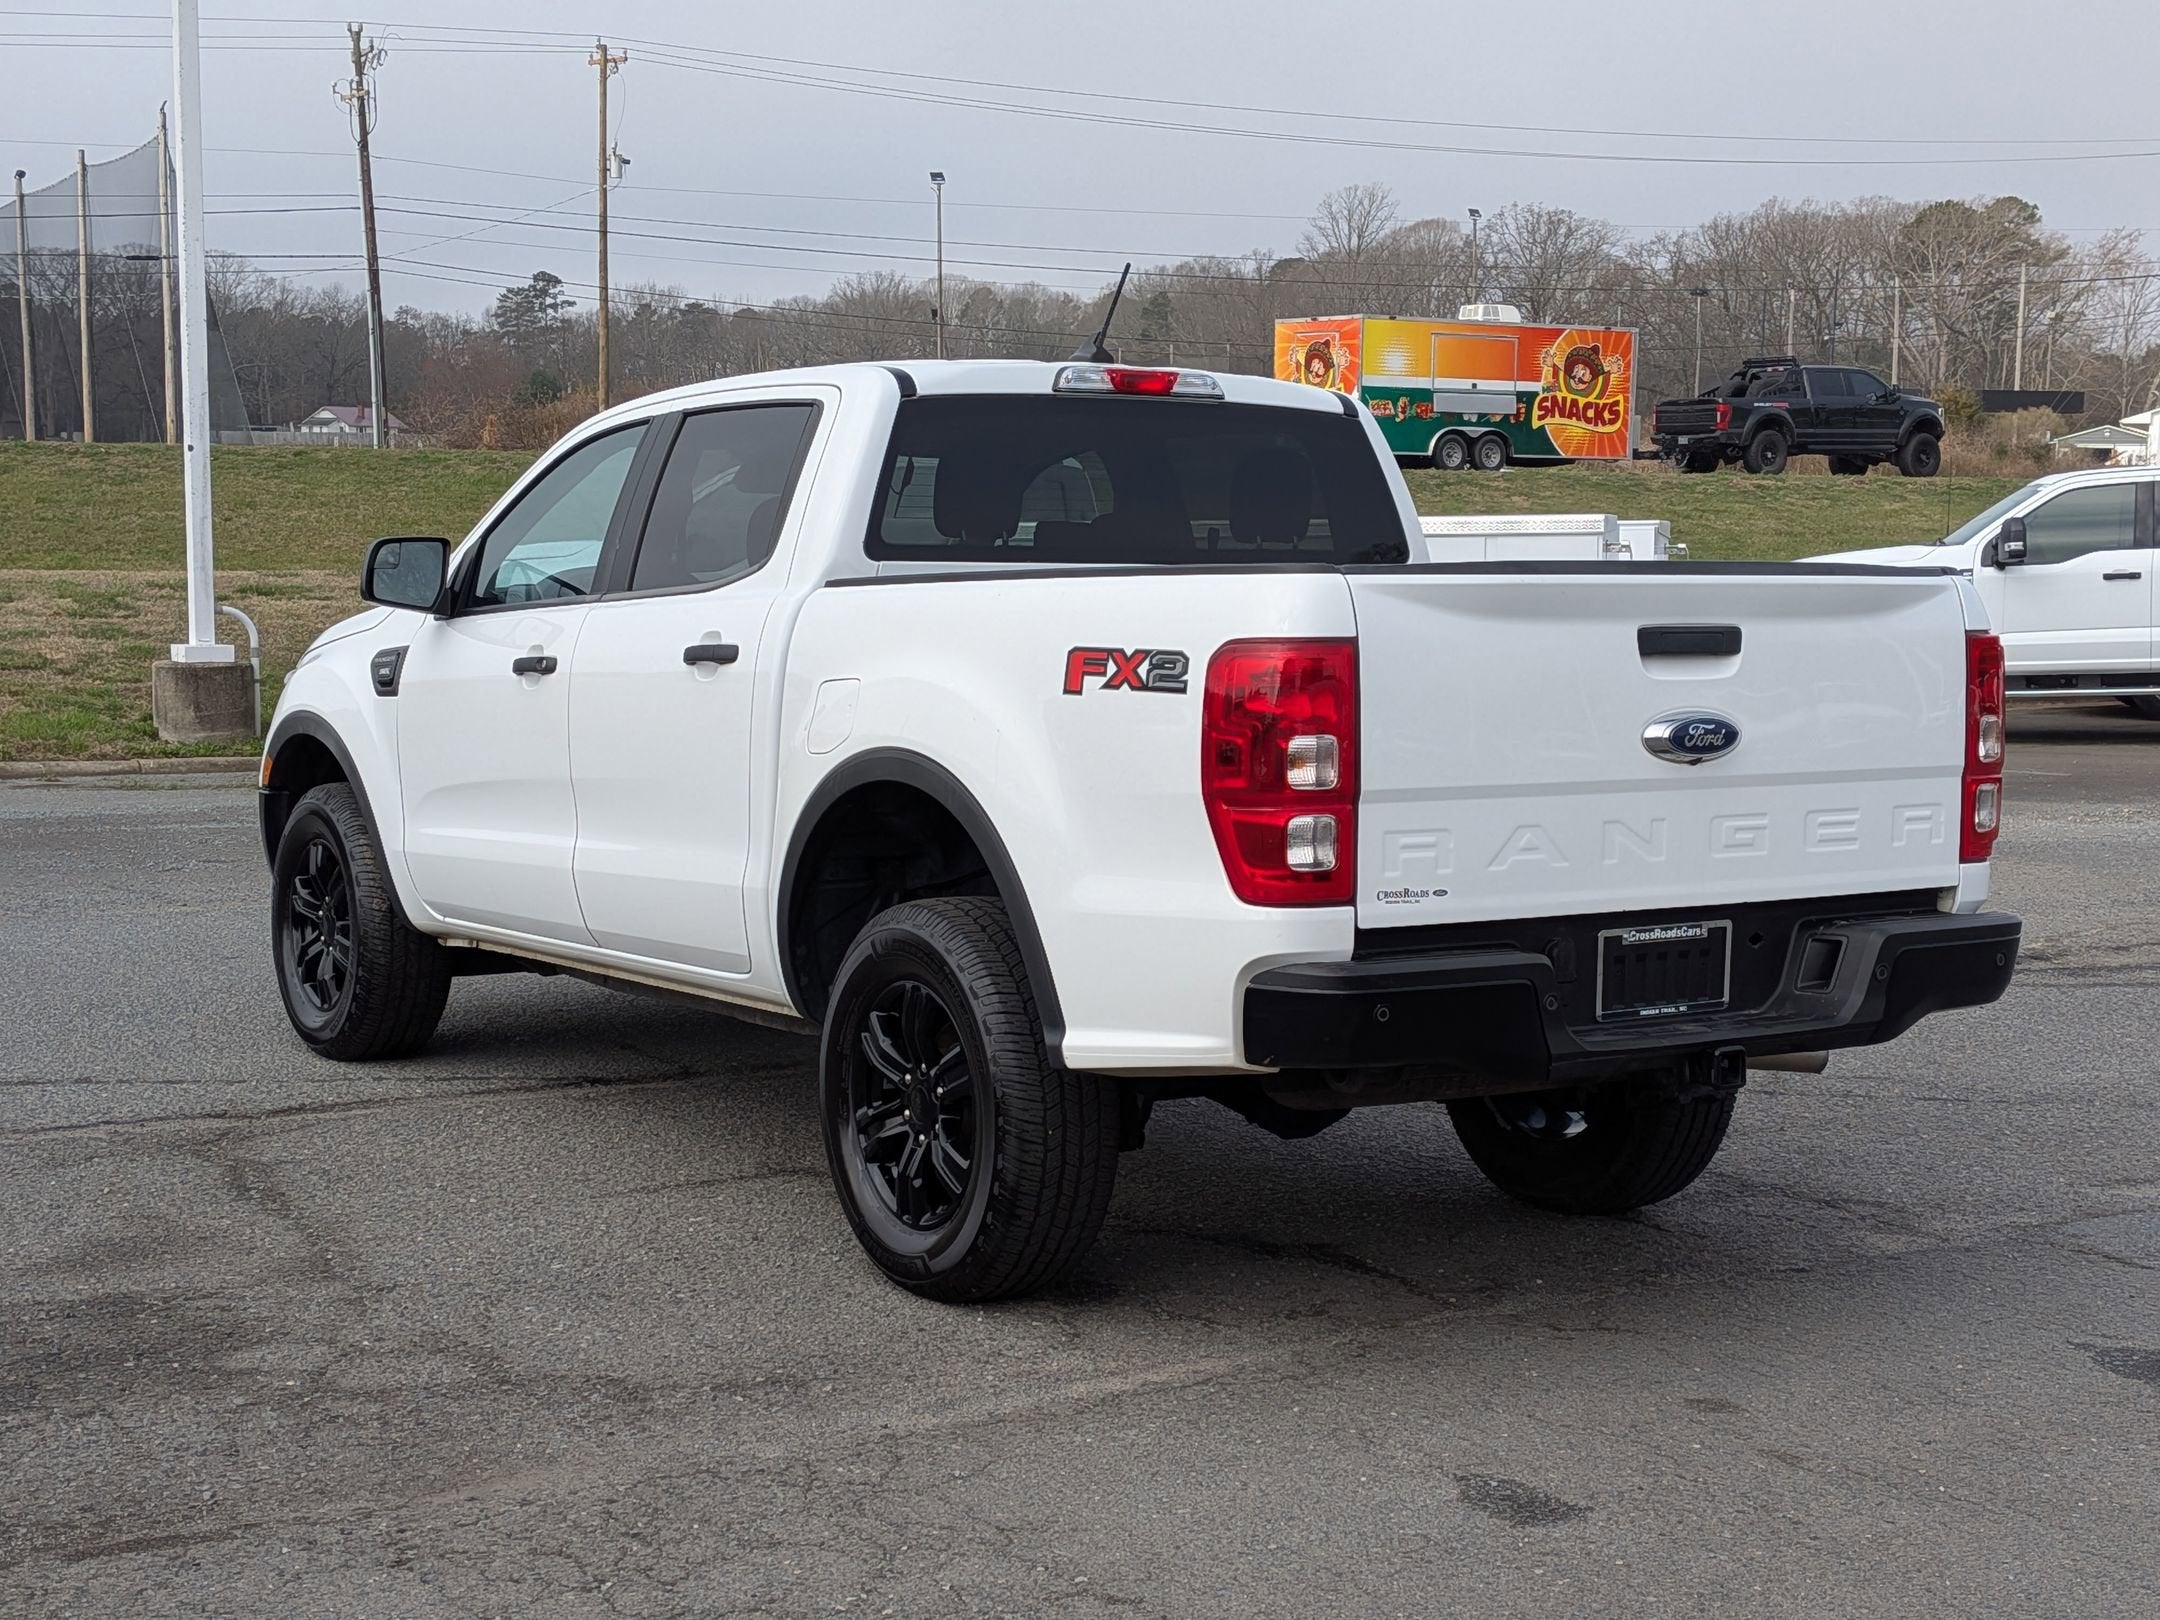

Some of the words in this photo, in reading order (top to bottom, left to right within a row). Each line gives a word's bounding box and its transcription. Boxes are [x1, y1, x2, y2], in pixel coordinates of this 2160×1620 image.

[1537, 394, 1621, 427] SNACKS
[1063, 646, 1190, 696] FX2
[1684, 723, 1726, 747] Ford
[1383, 803, 1945, 877] RANGER
